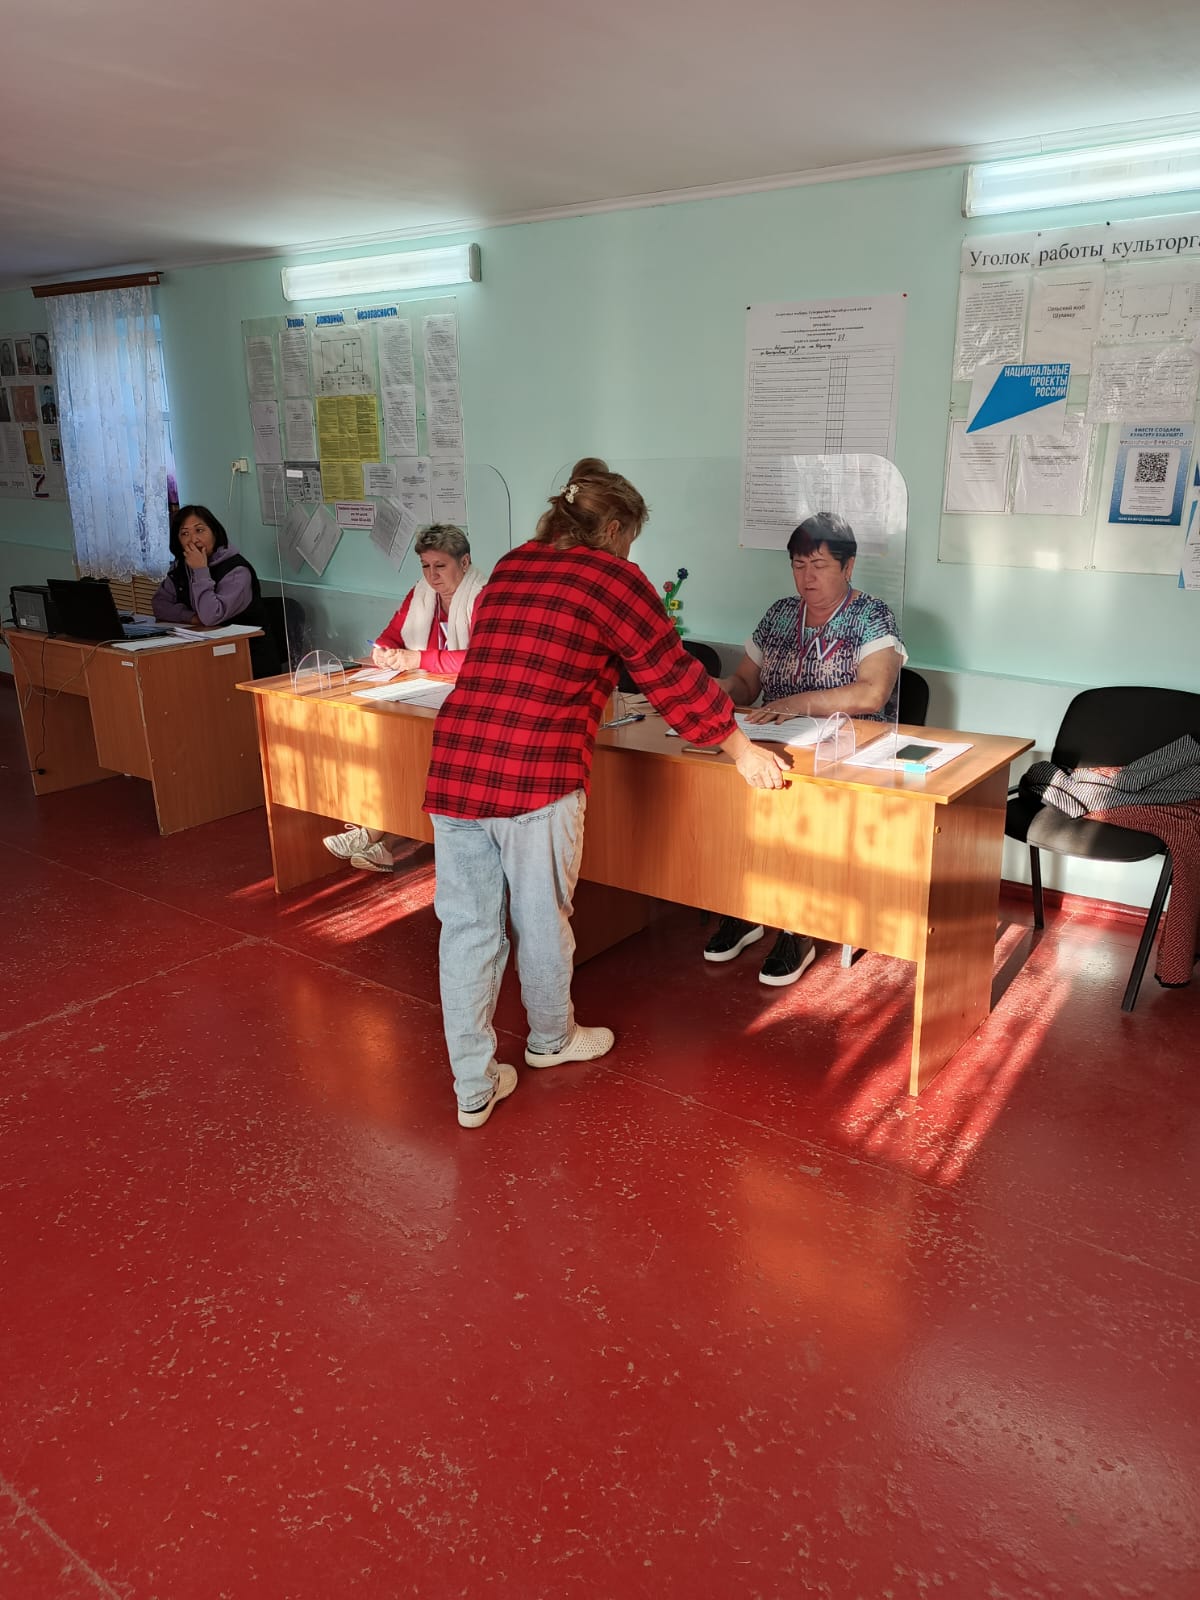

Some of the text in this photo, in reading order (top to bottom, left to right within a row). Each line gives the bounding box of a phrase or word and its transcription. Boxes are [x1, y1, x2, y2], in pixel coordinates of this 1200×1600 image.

[970, 235, 1200, 266] Уголок работы культорг
[1004, 364, 1070, 378] НАЦИОНАЛЬНЫЕ
[1030, 376, 1068, 387] ПРОЕКТЫ
[1035, 386, 1067, 397] РОССИИ
